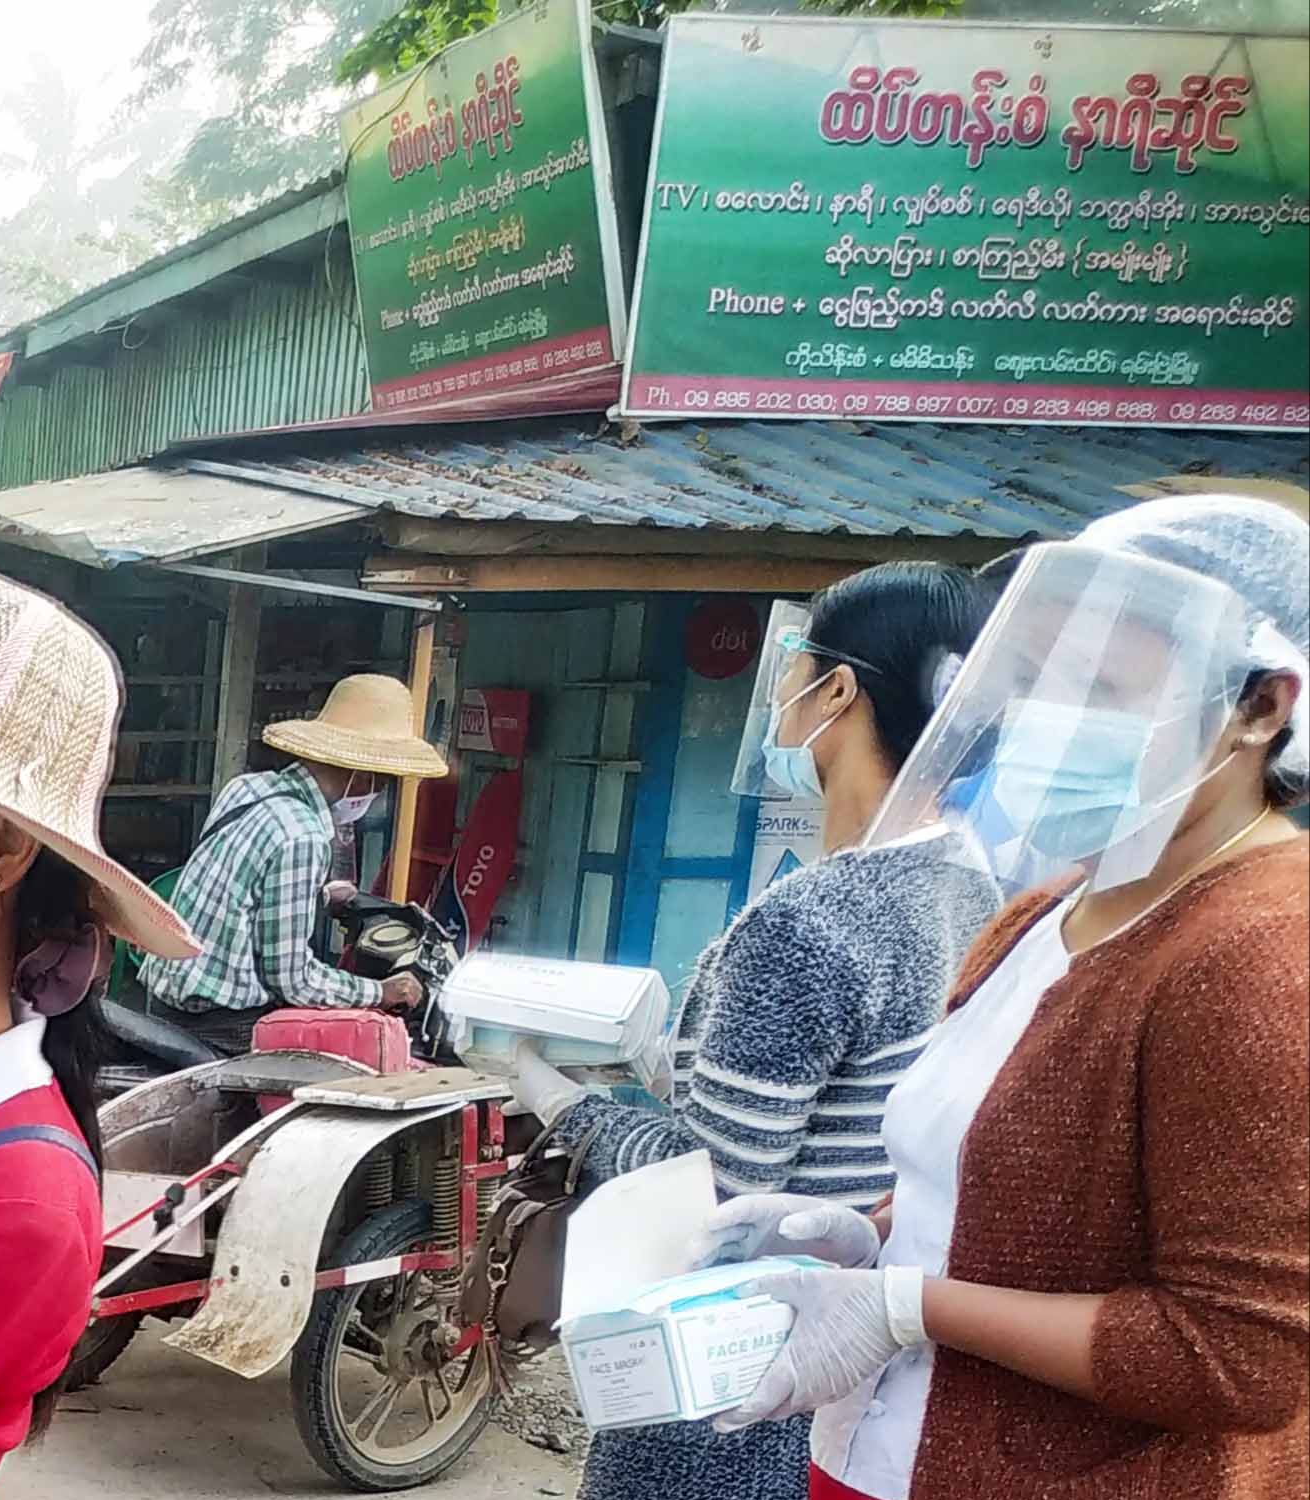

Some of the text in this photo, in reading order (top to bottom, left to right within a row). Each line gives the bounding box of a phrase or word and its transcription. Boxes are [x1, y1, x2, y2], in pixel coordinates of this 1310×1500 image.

[1061, 72, 1250, 174] နာရီဆိုင်
[657, 183, 698, 212] TV
[829, 184, 875, 225] နာရီ
[707, 286, 785, 316] Phone
[1042, 291, 1148, 324] လက်ကား
[684, 390, 709, 408] 09
[755, 391, 792, 410] 202
[843, 395, 868, 411] 09
[1003, 398, 1029, 415] 09
[1169, 403, 1196, 420] 09
[754, 816, 802, 832] SPARK
[461, 845, 495, 898] TOYO
[706, 1341, 748, 1361] FACE
